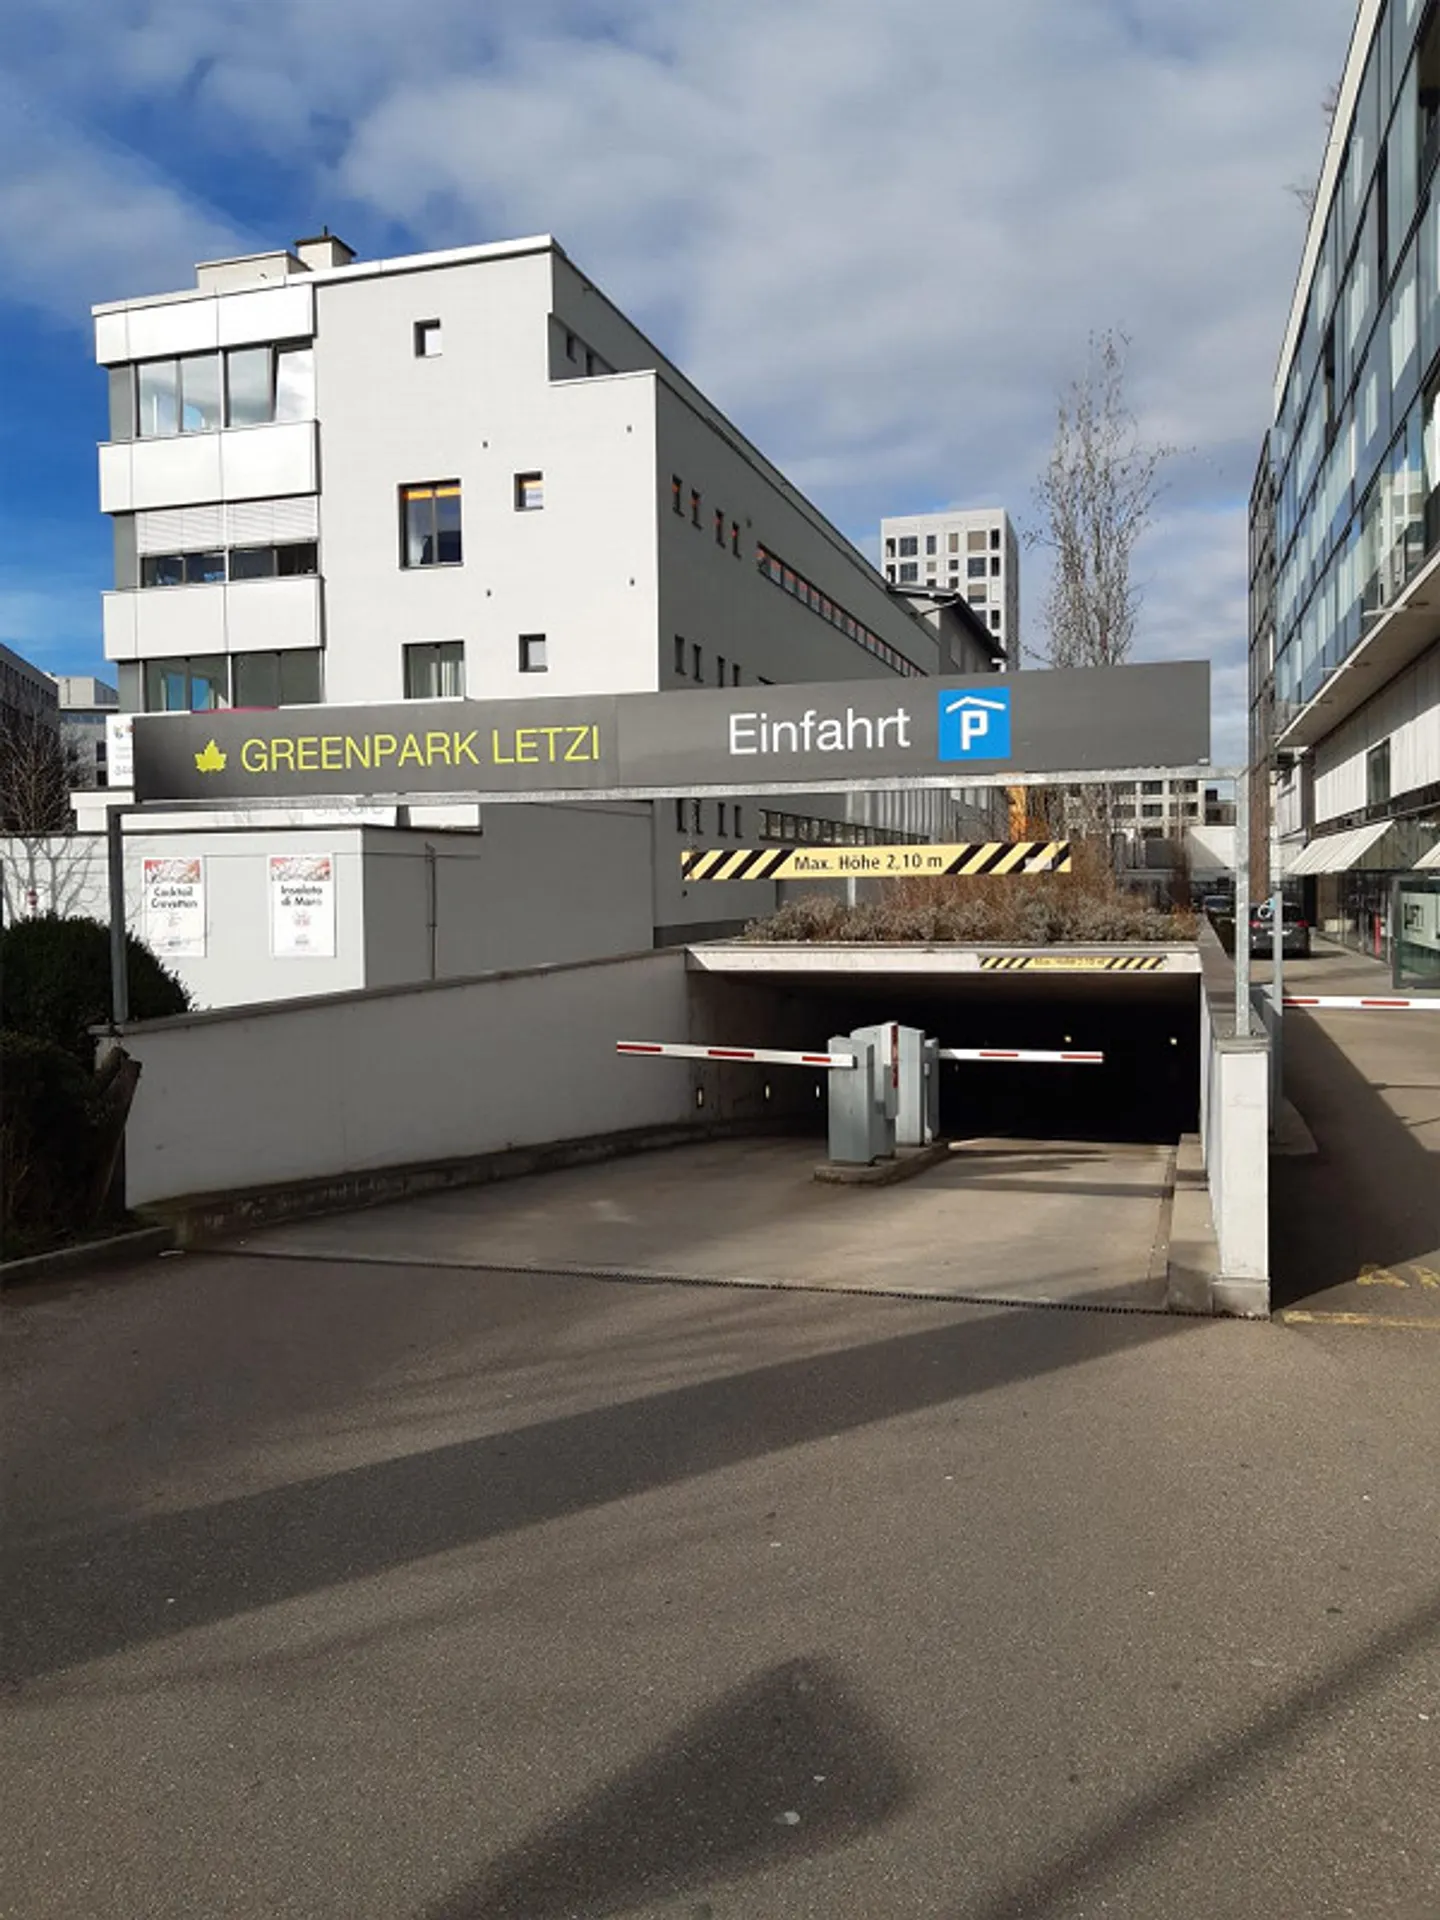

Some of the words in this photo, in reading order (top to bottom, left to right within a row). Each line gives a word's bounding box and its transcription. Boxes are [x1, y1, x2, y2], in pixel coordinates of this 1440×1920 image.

[240, 729, 480, 773] GREENPARK
[492, 724, 600, 765] LETZI
[728, 707, 911, 755] Einfahrt
[961, 709, 988, 751] P
[794, 856, 833, 870] Max.
[839, 853, 880, 870] Höhe
[927, 856, 943, 868] m
